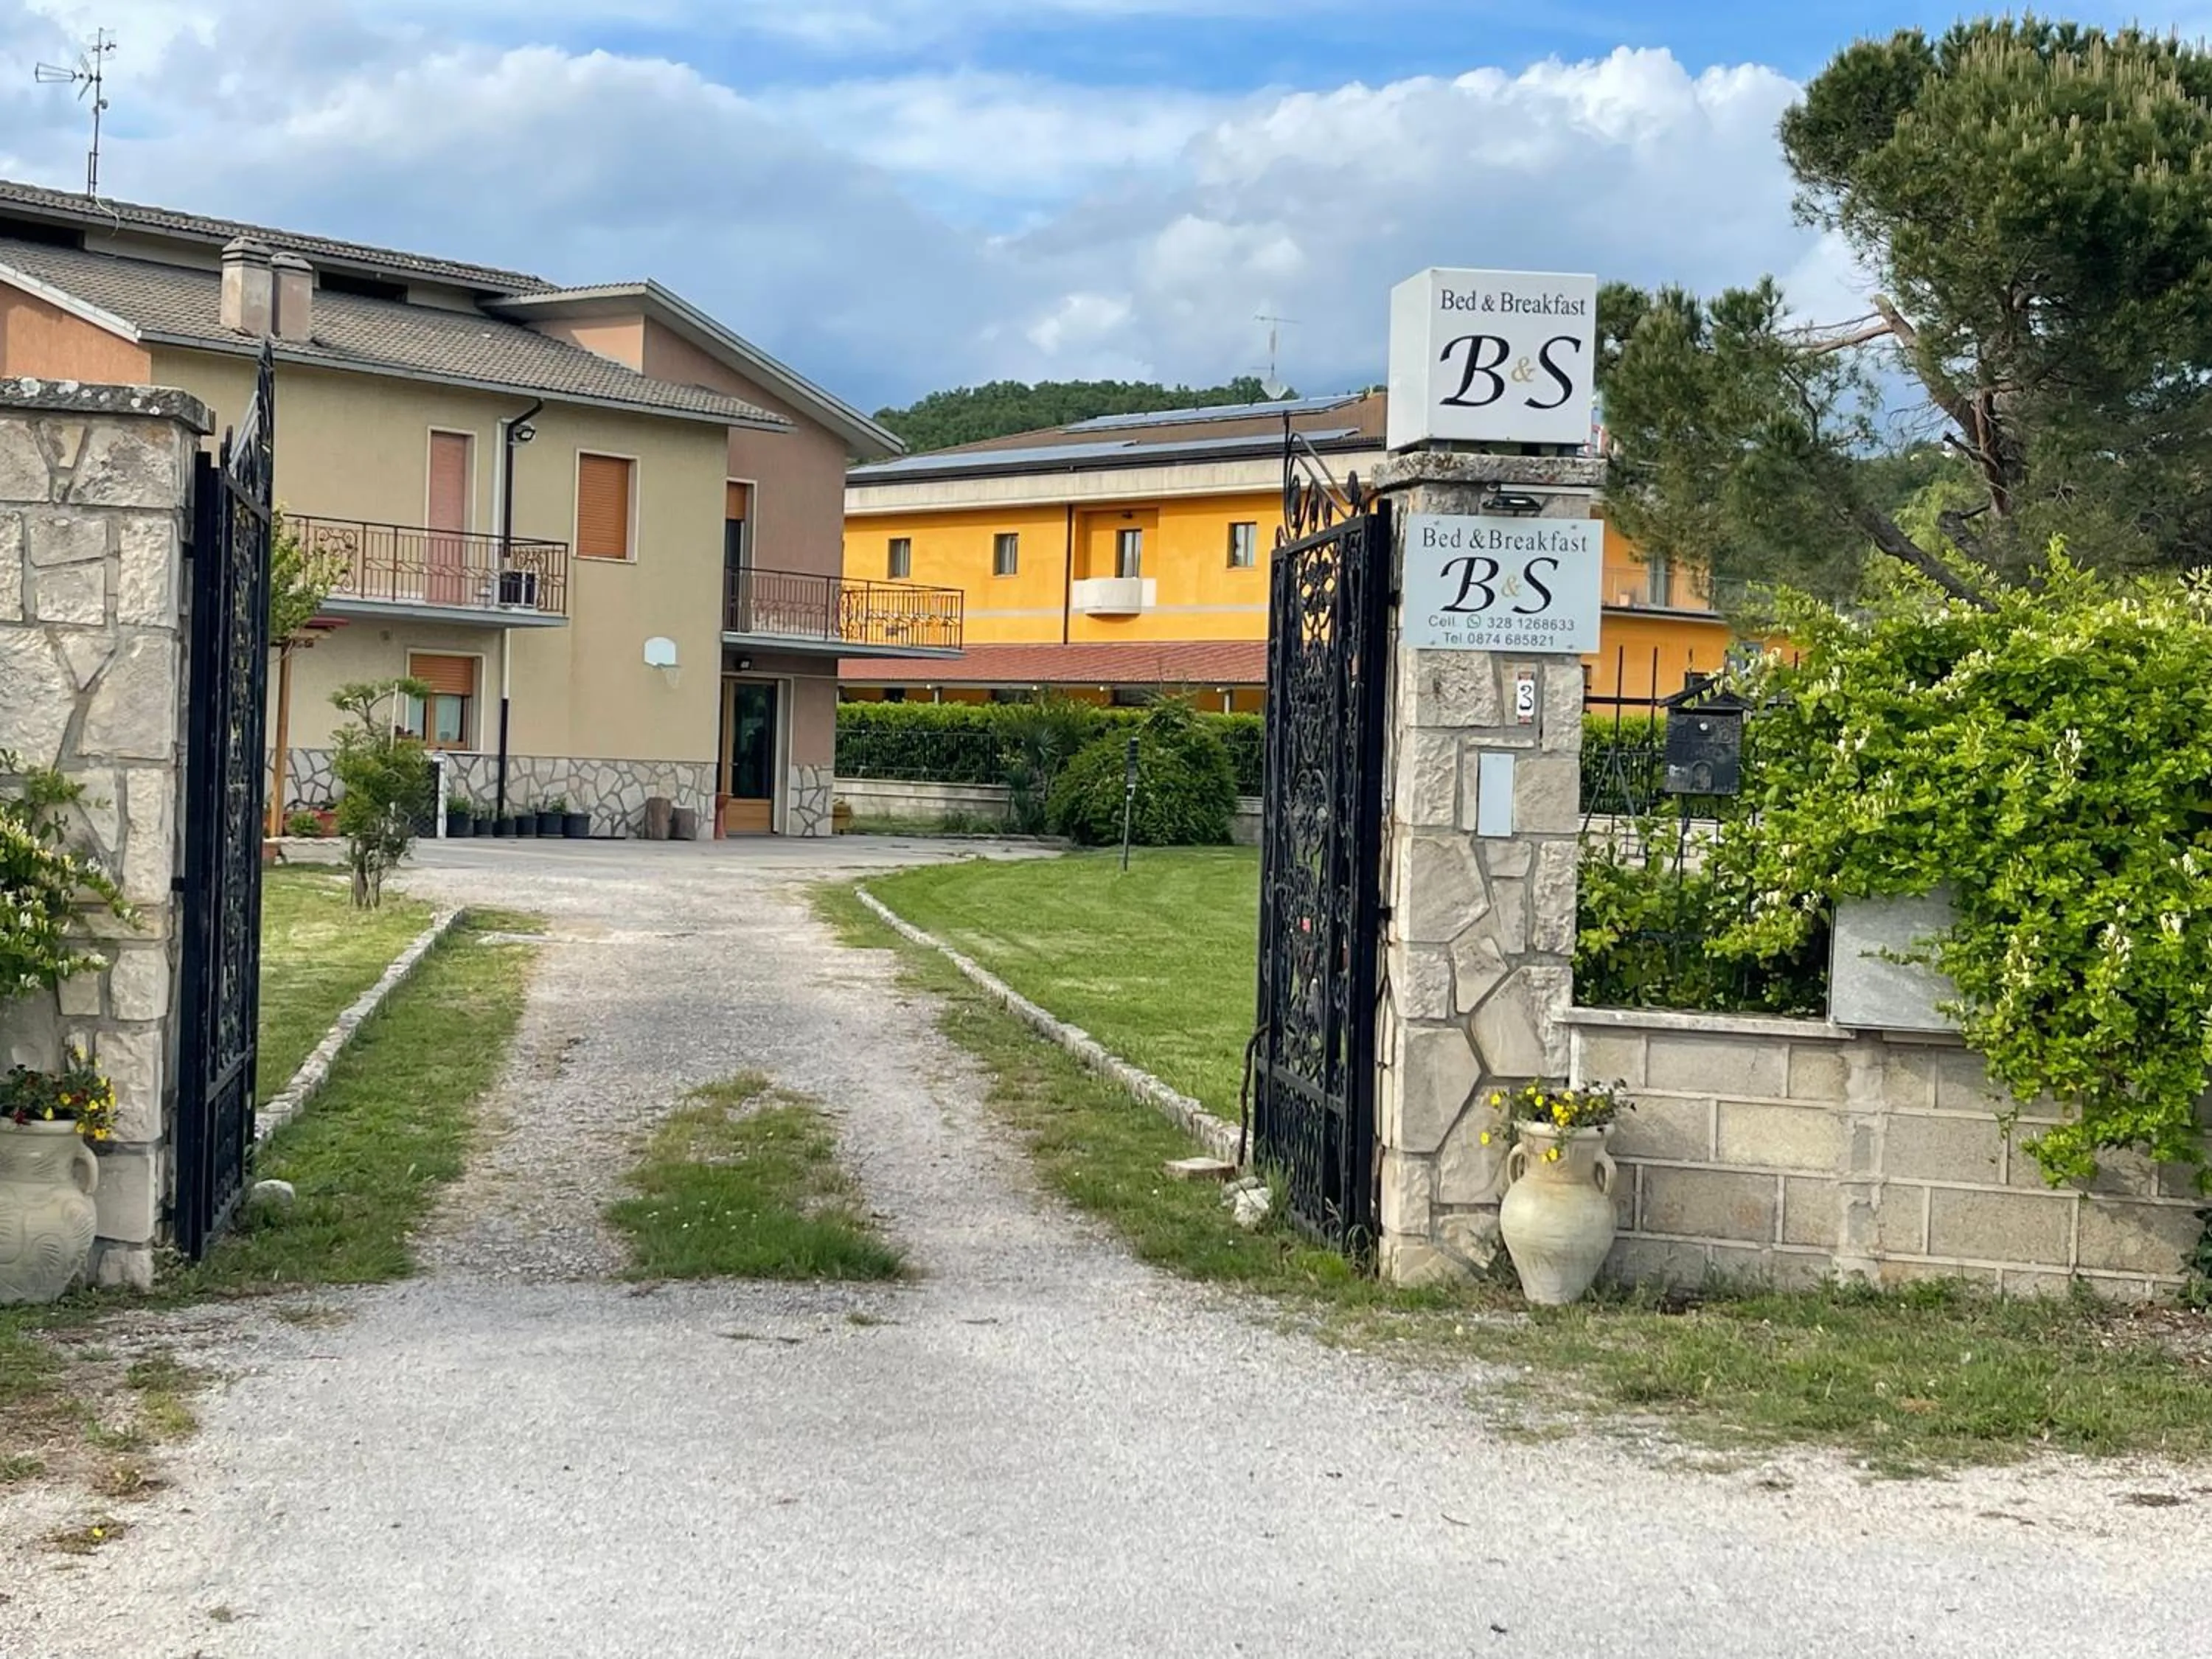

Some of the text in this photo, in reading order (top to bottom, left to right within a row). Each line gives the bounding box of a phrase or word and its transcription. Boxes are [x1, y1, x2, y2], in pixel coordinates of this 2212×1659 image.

[1440, 288, 1586, 316] Bed & Breakfast
[1422, 527, 1461, 549] Bed
[1486, 616, 1512, 629] 328
[1517, 618, 1575, 631] 1268633
[1467, 633, 1501, 645] 0874
[1505, 634, 1554, 647] 685821
[1519, 685, 1533, 711] 3
